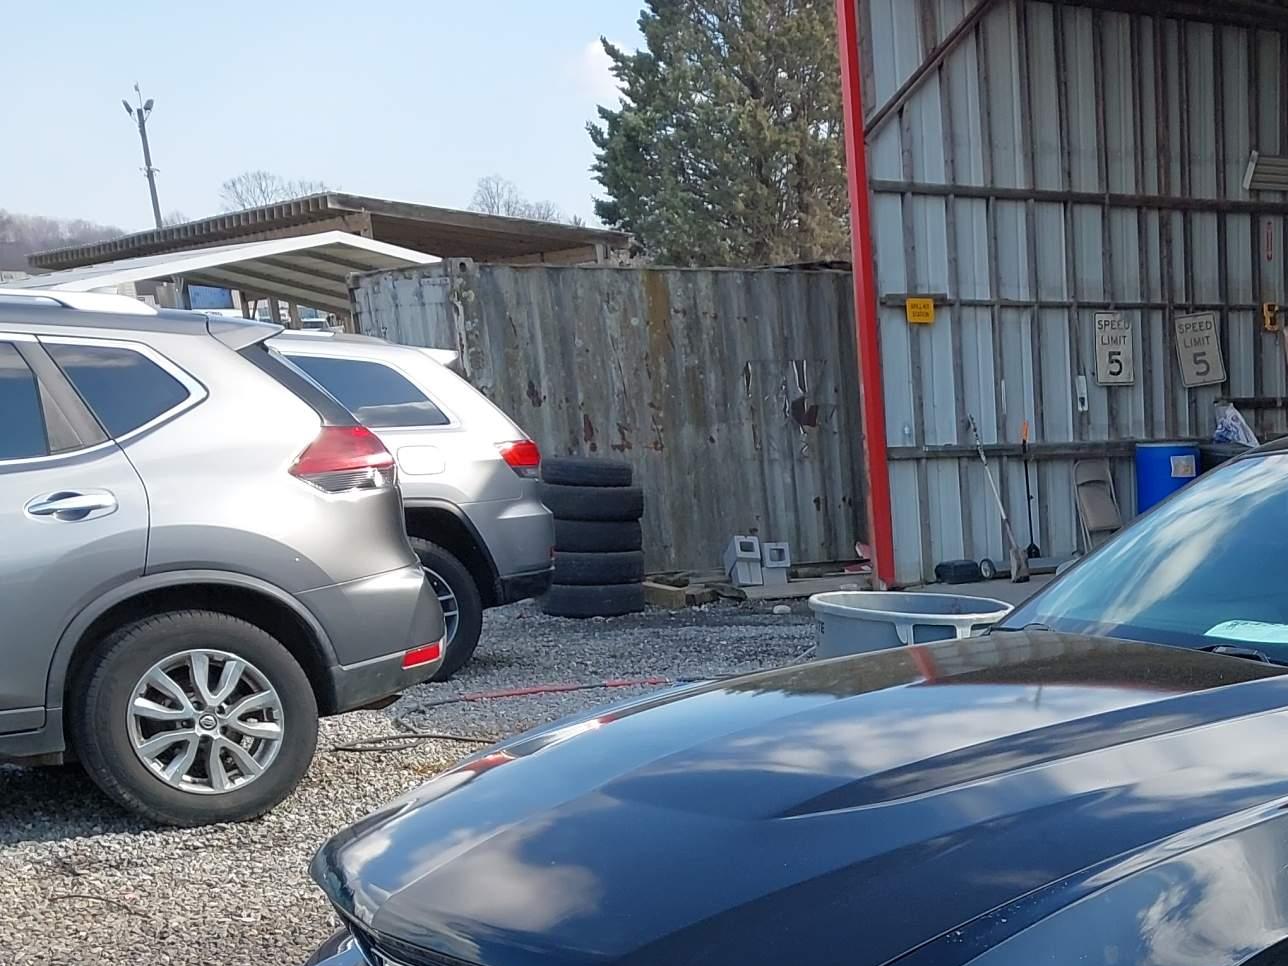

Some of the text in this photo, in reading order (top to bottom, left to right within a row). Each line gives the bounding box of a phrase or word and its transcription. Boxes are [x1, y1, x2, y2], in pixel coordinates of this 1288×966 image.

[1097, 319, 1130, 330] SPEED
[1178, 320, 1213, 335] SPEED
[1101, 335, 1127, 346] LIMIT
[1184, 335, 1210, 348] LIMIT
[1108, 351, 1123, 376] 5
[1193, 352, 1210, 376] 5
